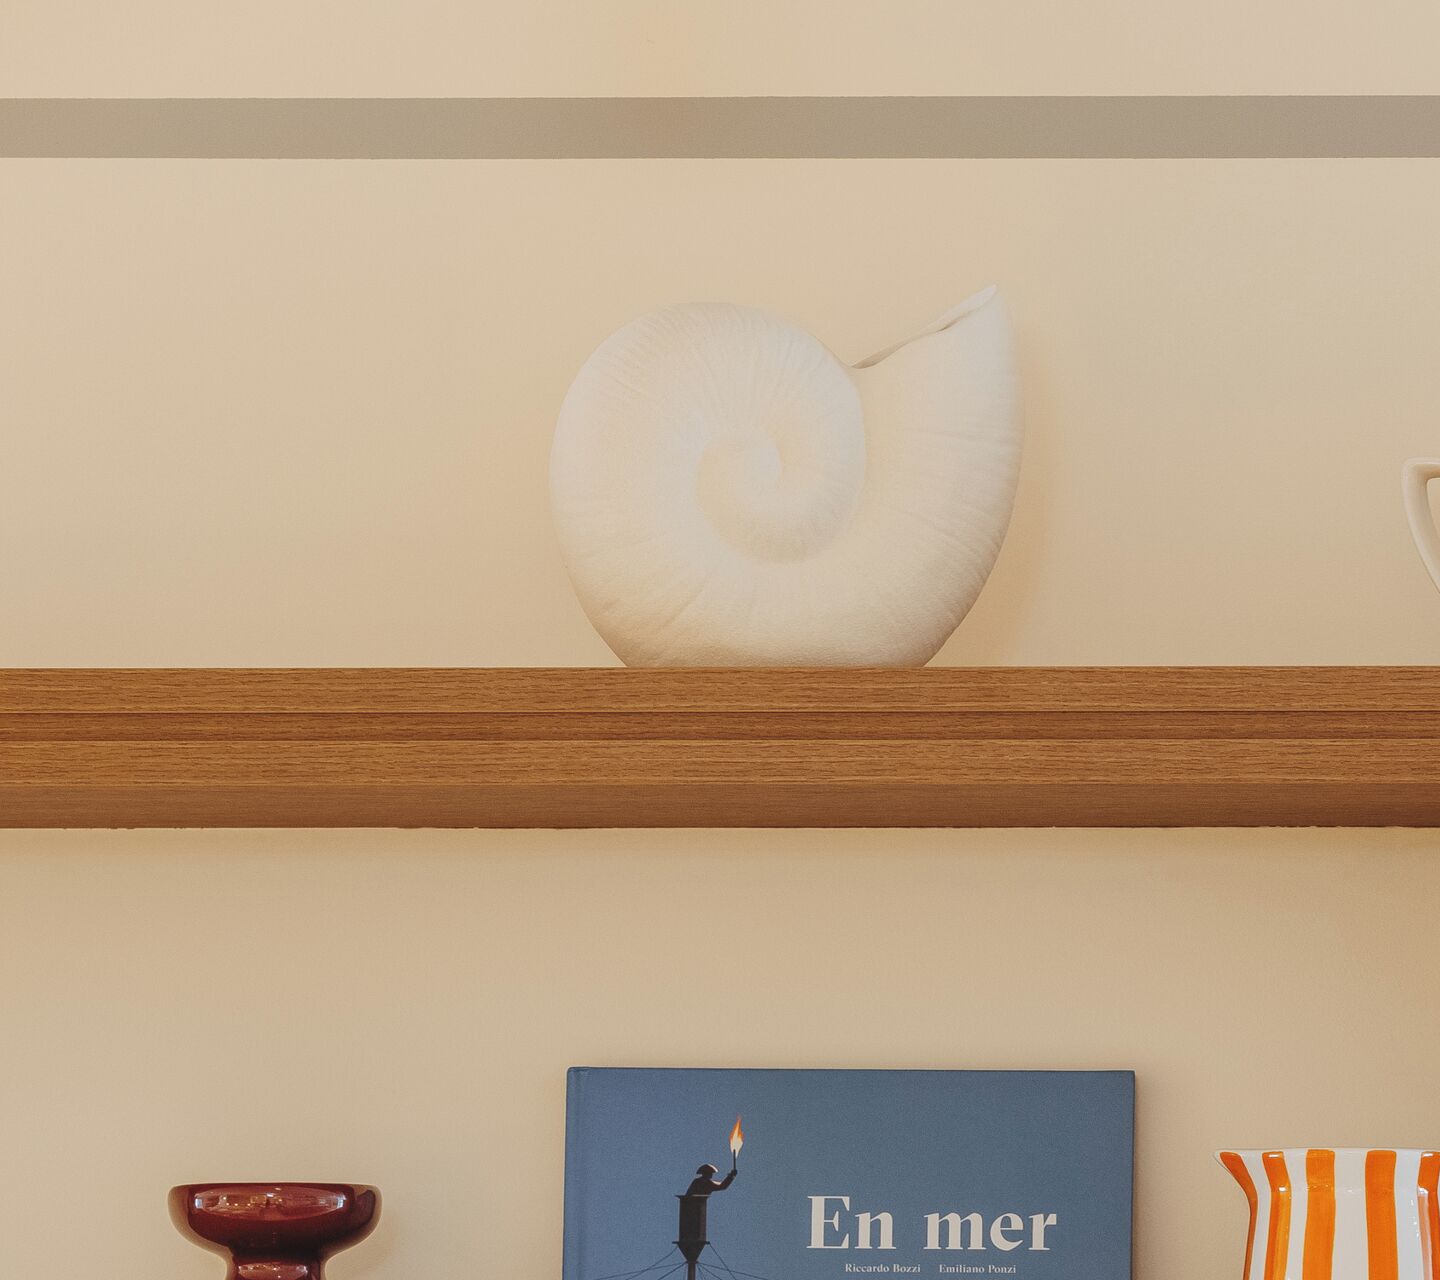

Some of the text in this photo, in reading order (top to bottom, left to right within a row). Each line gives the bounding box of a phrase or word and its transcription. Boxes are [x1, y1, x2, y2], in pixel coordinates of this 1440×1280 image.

[806, 1195, 1057, 1252] En mer
[845, 1263, 921, 1273] Riccardo Bozzi
[939, 1263, 1017, 1274] Emiliano Ponzi
